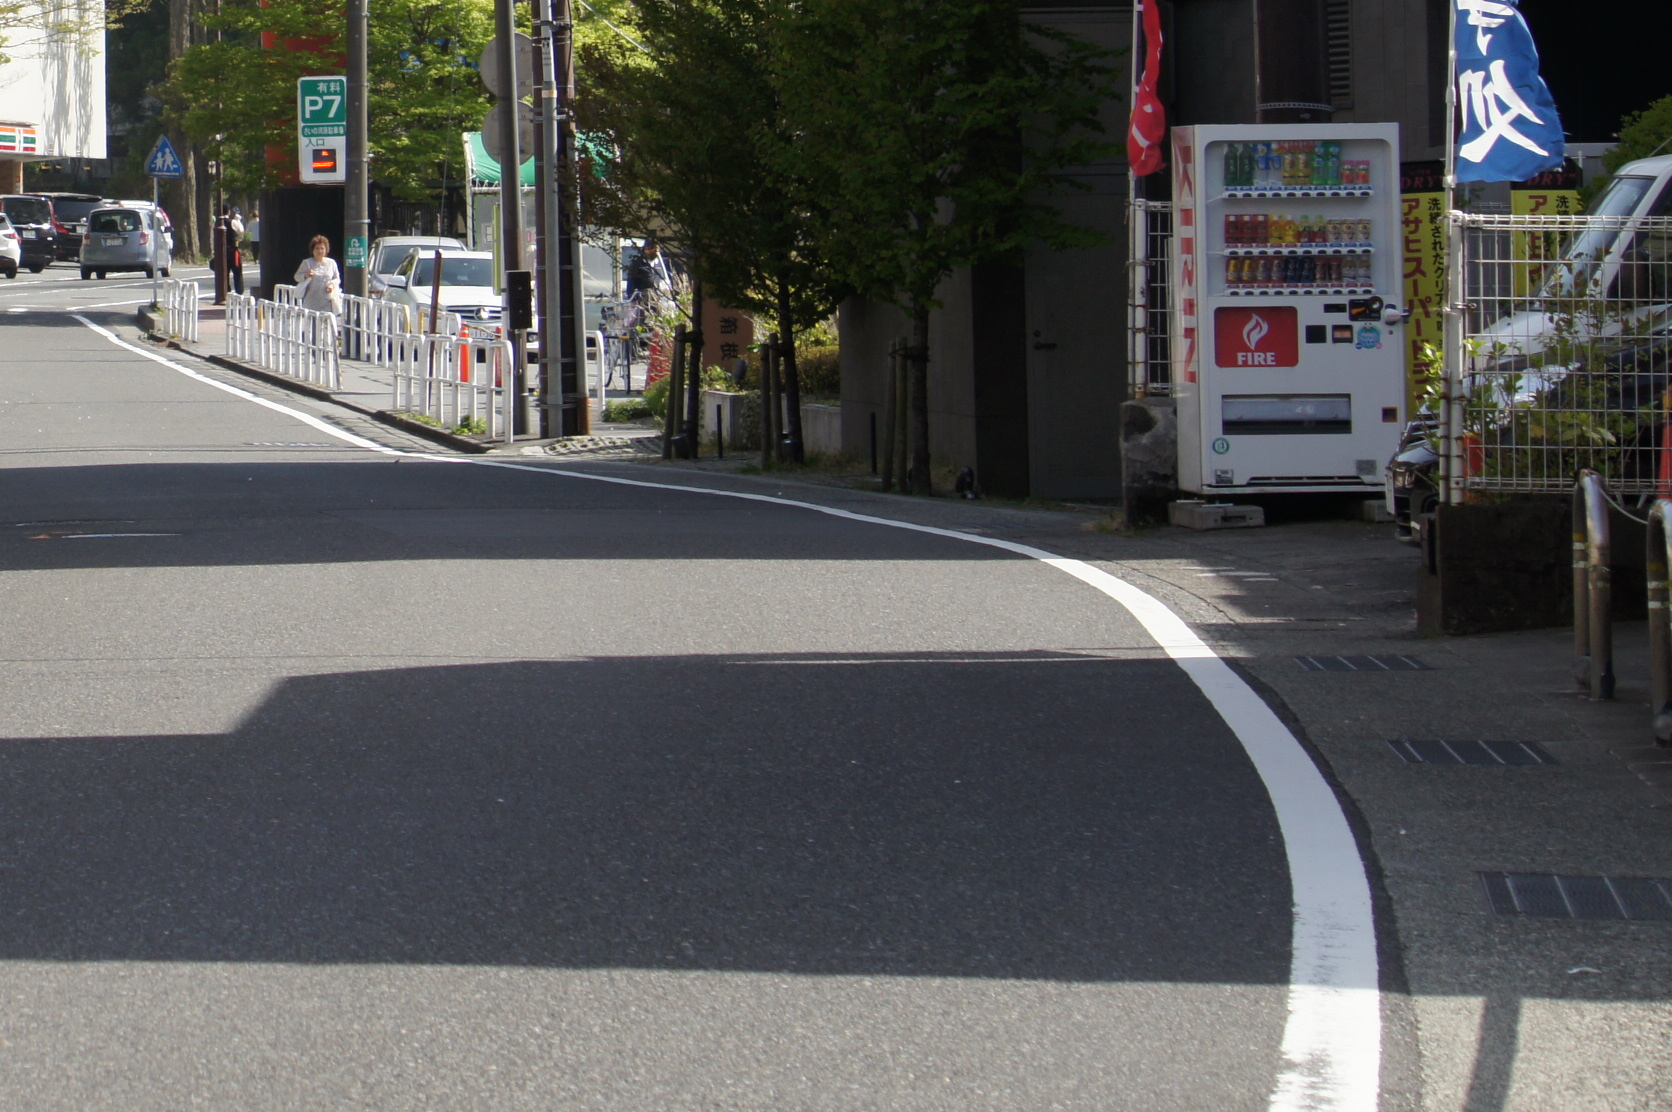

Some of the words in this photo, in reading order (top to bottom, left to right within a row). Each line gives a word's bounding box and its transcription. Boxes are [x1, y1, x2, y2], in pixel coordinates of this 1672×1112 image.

[317, 81, 341, 94] 有料
[304, 95, 342, 119] P7
[305, 138, 325, 148] 入口
[1179, 144, 1197, 384] KIRIN
[1401, 198, 1433, 399] アサヒスーパードラ
[1237, 352, 1276, 365] FIRE
